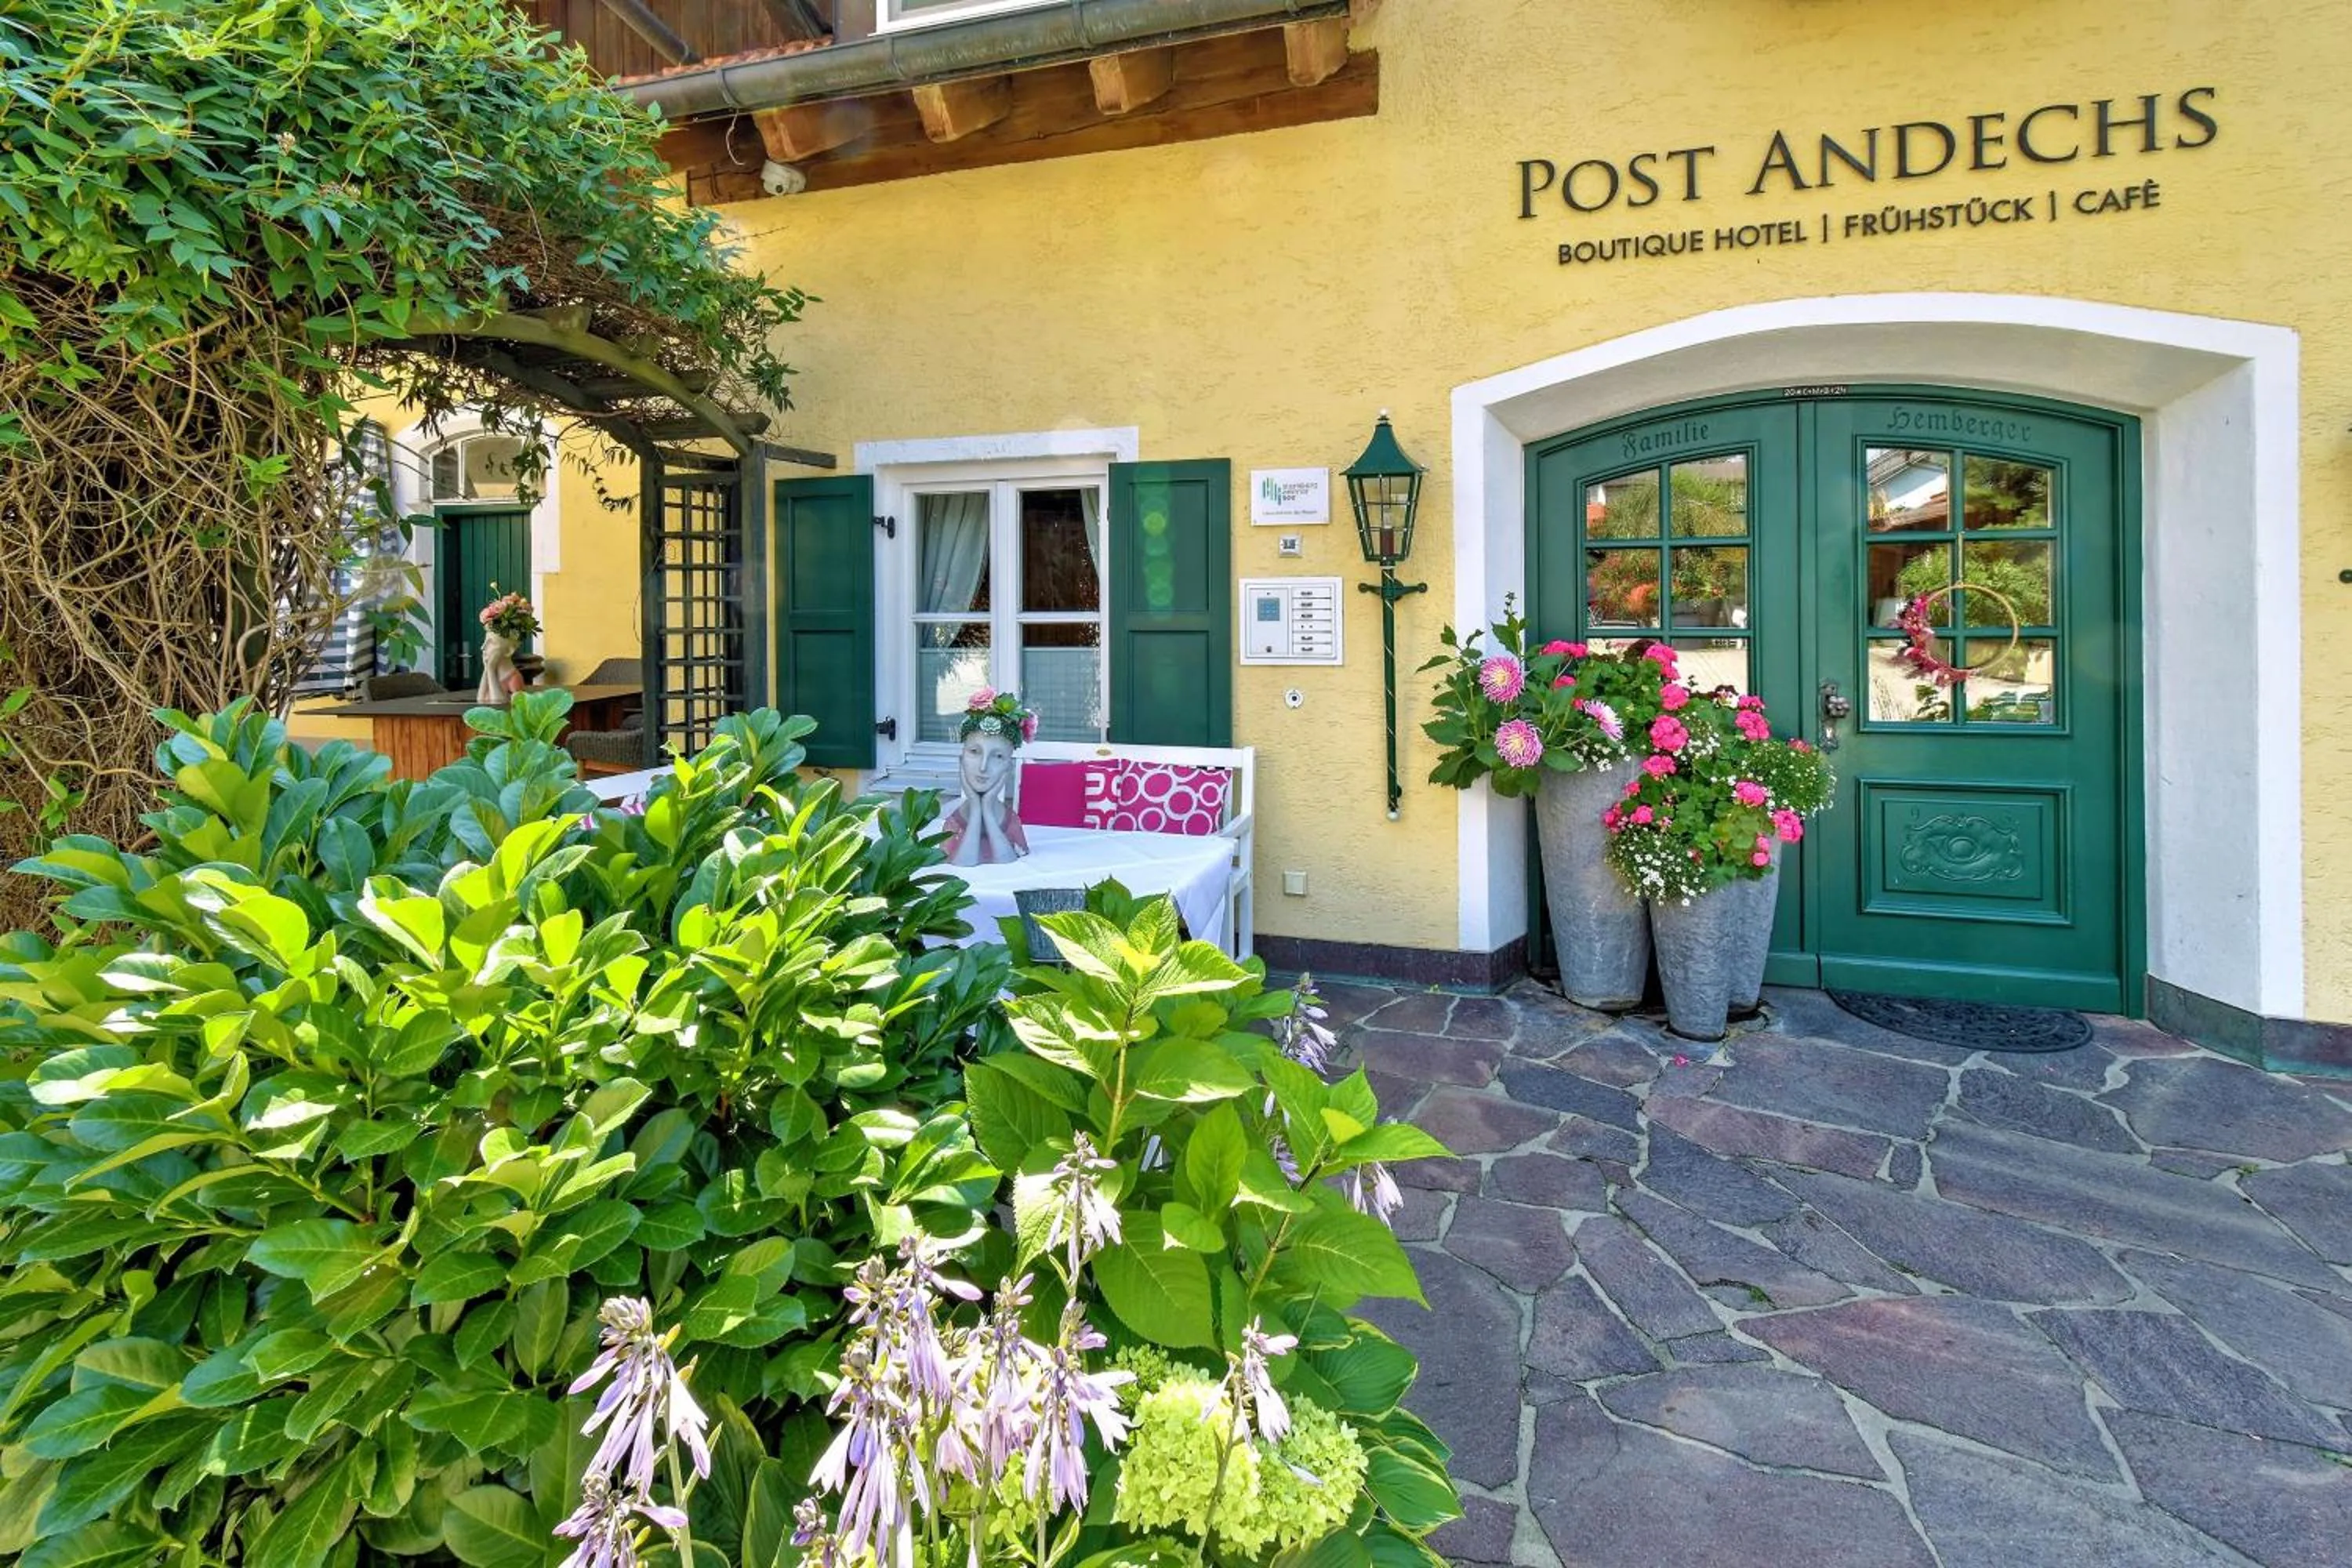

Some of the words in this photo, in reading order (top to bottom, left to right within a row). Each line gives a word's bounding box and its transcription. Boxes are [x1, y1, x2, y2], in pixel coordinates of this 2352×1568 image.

[1517, 146, 1715, 220] POST
[1744, 87, 2218, 196] ANDECHS
[1557, 229, 1704, 266] BOUTIQUE
[1714, 220, 1808, 251] HOTEL
[1844, 196, 2034, 238] FRÜHSTÜCK
[2072, 178, 2161, 215] CAFÉ
[1622, 422, 1709, 459] Familie
[1886, 405, 2031, 441] Hemberger
